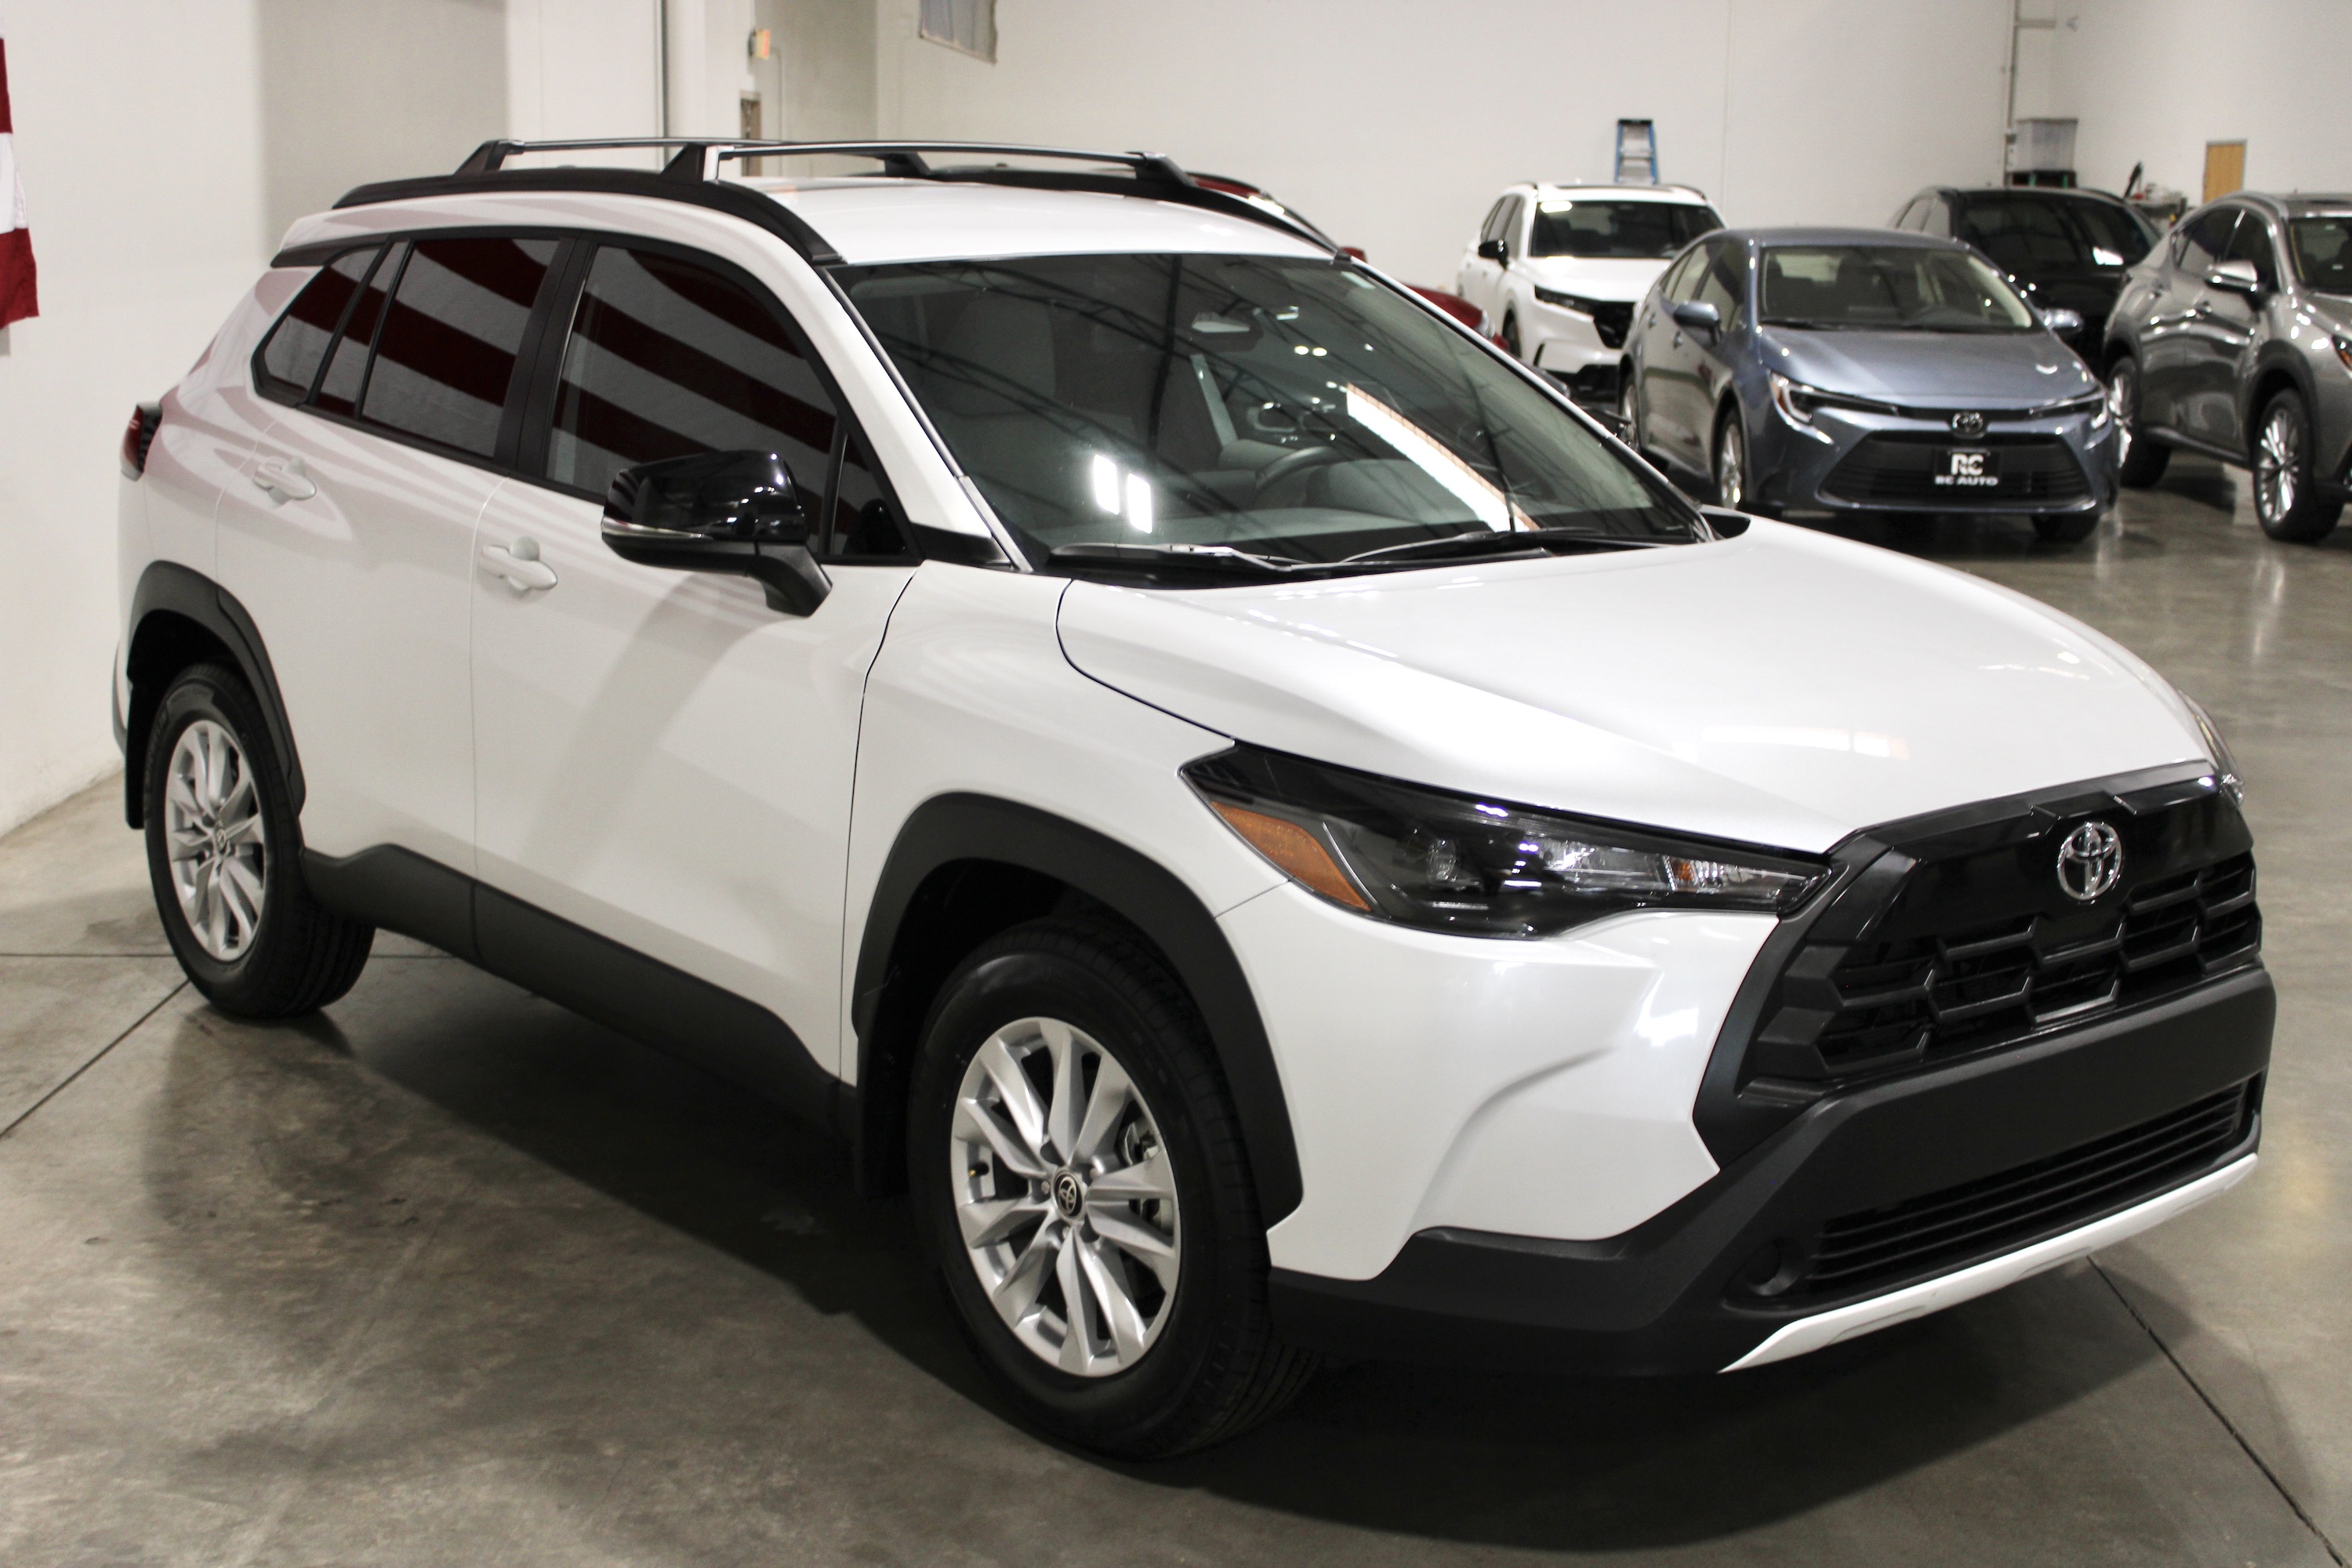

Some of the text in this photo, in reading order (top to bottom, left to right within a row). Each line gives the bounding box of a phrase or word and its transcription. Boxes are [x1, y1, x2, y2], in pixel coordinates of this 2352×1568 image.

[1951, 454, 1984, 475] RC
[1934, 475, 1998, 486] RC AUTO
